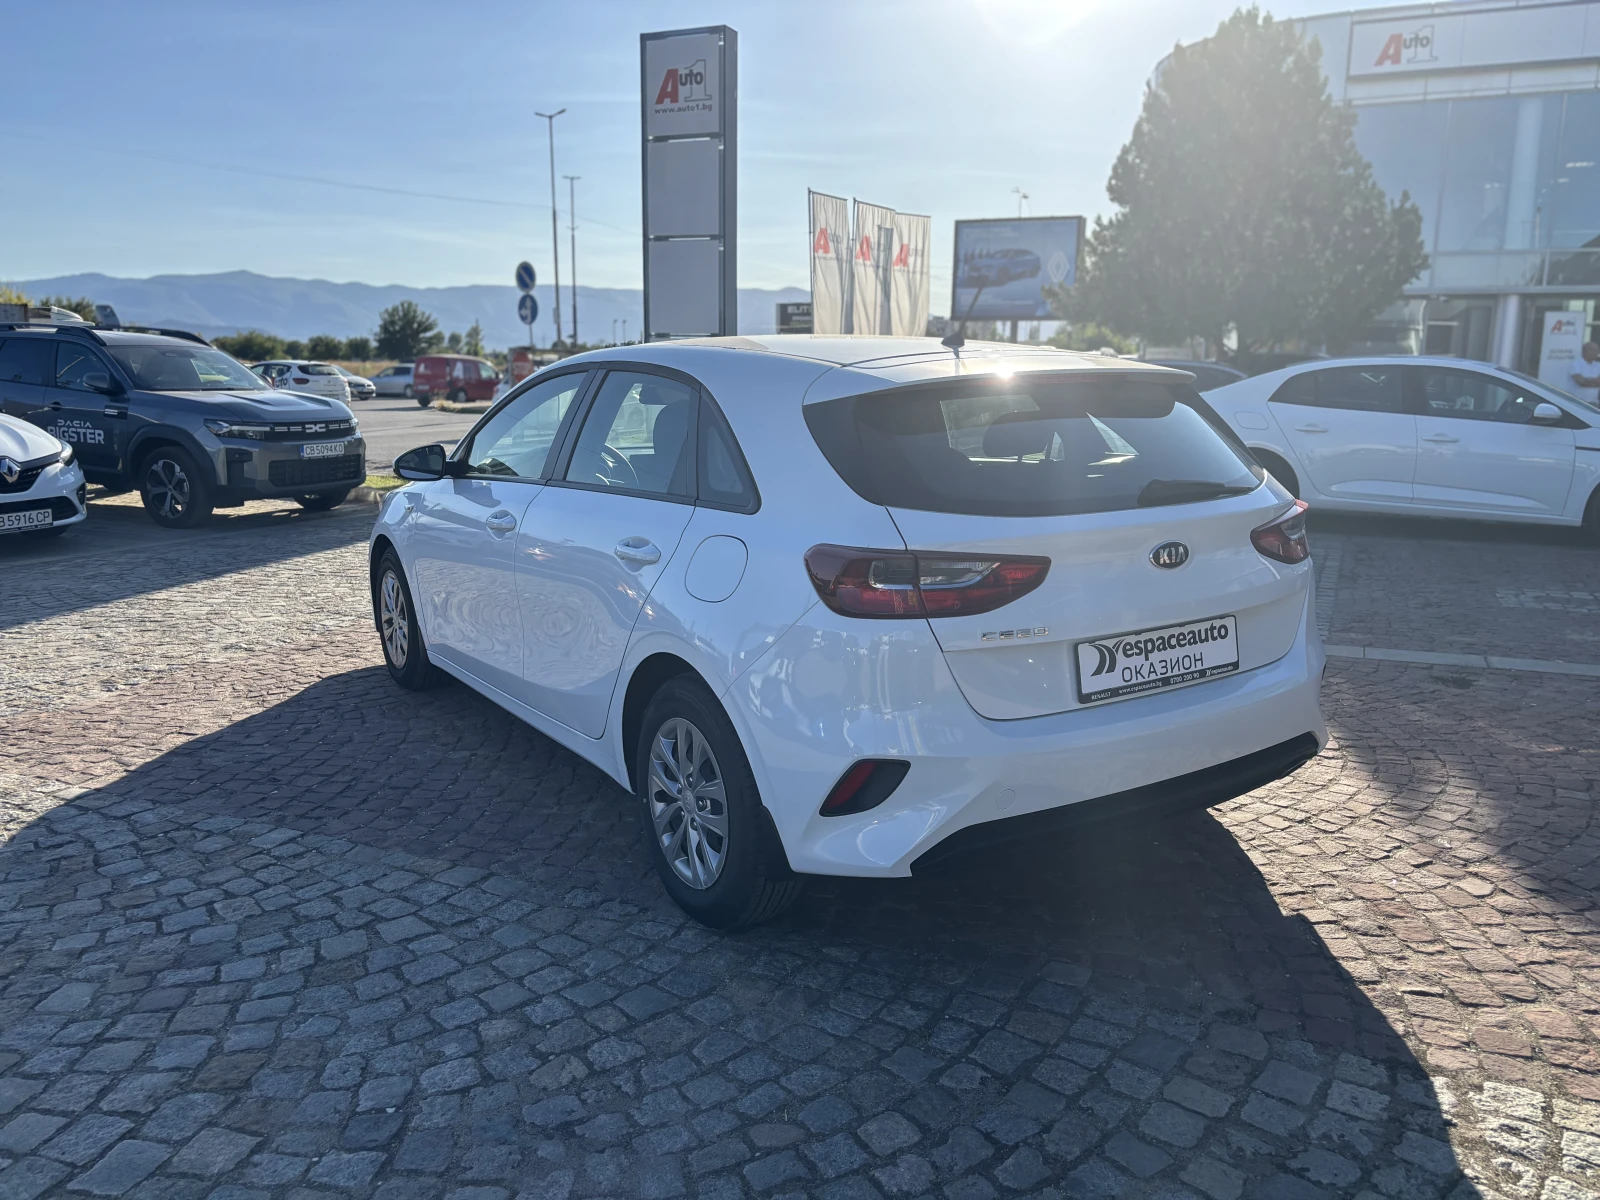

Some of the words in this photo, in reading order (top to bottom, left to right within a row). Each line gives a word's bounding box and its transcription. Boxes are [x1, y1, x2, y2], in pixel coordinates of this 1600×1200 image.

[654, 103, 713, 114] www.auto1.bg
[57, 419, 92, 428] DACIA
[47, 426, 105, 444] BIGSTER
[1159, 546, 1186, 565] KIA
[1121, 622, 1229, 661] espaceauto
[1121, 652, 1204, 683] ОКАЗИОН
[1091, 691, 1112, 700] RENAULT
[1118, 681, 1163, 694] www.espaceauto.bg
